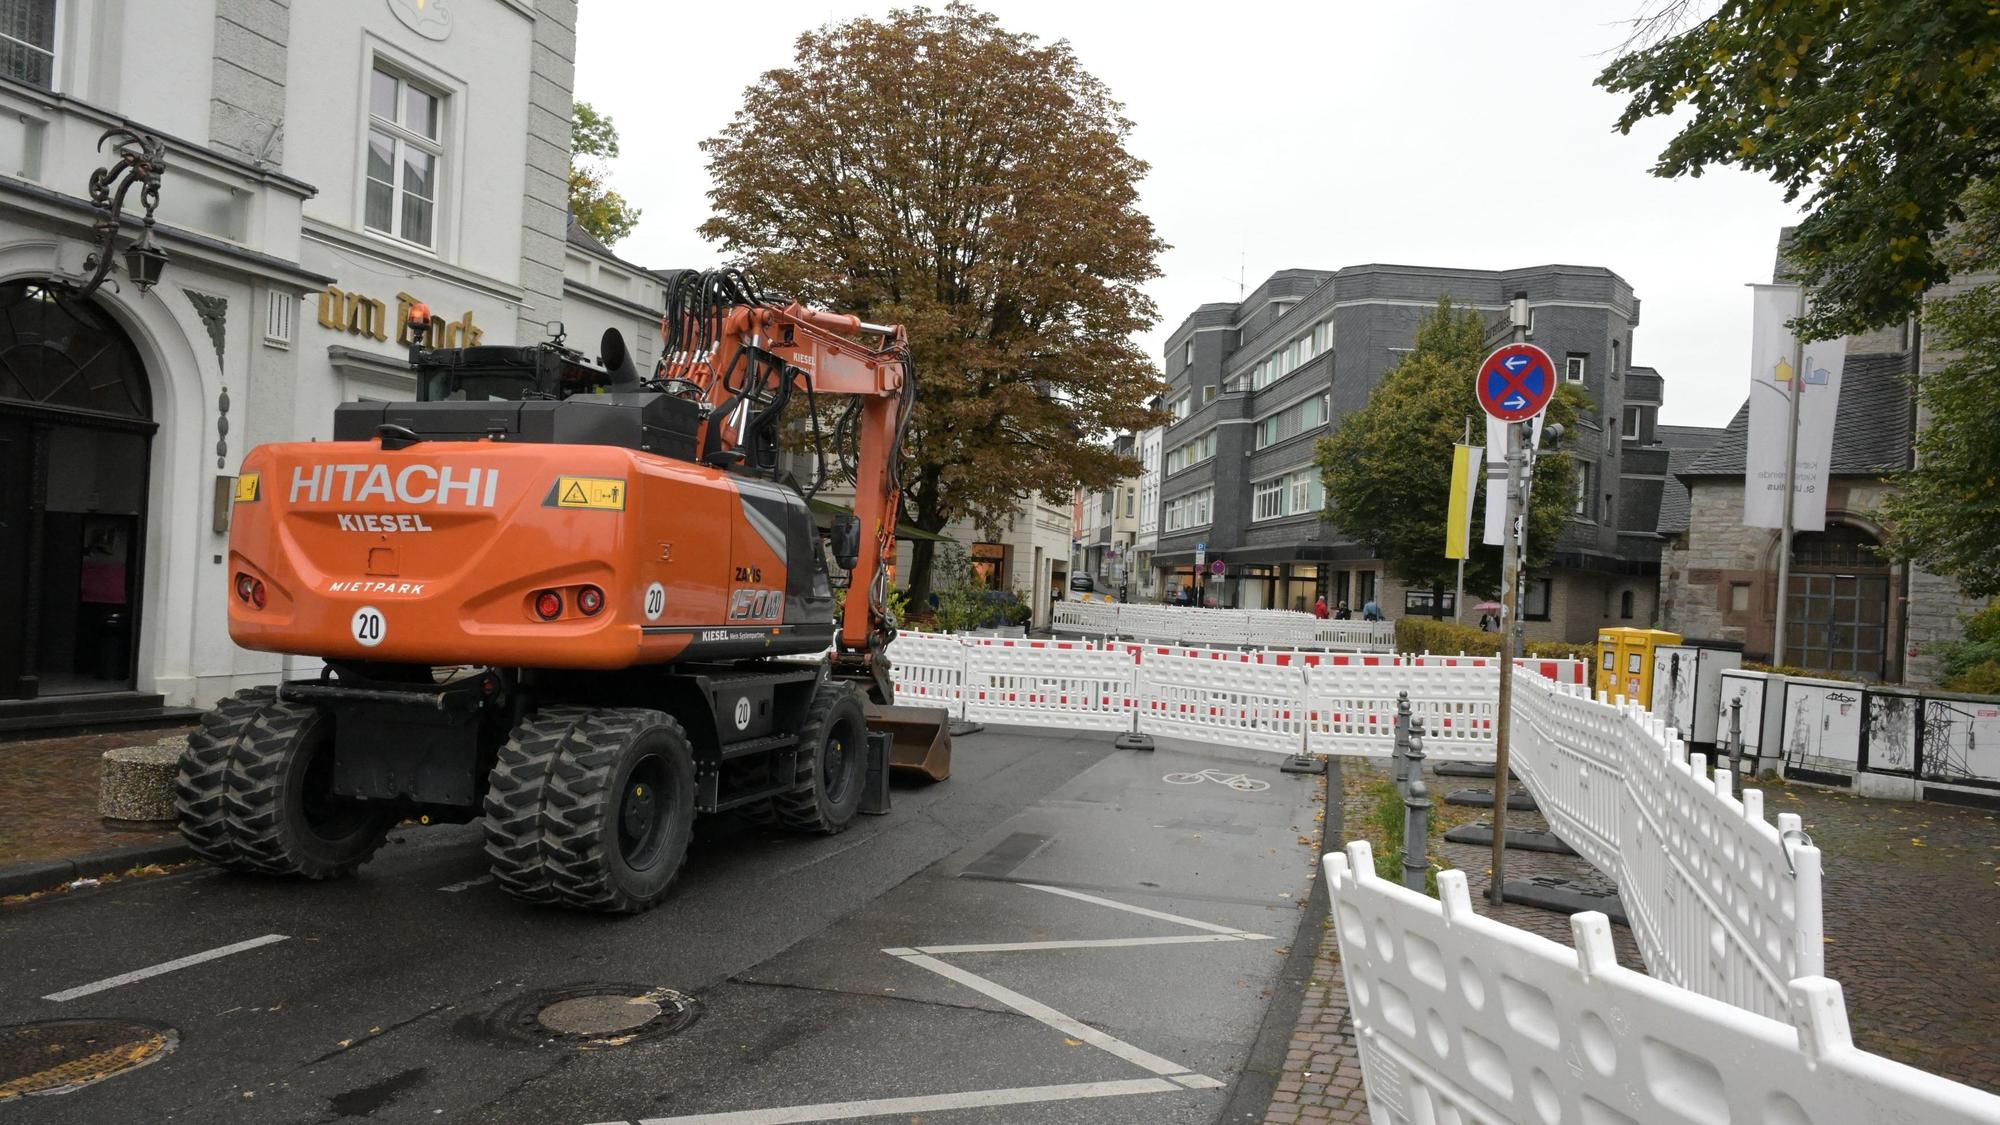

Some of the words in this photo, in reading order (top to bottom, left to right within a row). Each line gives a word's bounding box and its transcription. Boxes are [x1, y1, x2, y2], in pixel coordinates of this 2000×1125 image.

[318, 286, 388, 343] am
[793, 352, 816, 365] KIESEL
[289, 464, 499, 507] HITACHI
[336, 513, 432, 532] KIESEL
[329, 582, 424, 594] MIETPARK
[647, 589, 662, 614] 20
[729, 589, 783, 620] 150W
[358, 613, 380, 640] 20
[702, 630, 729, 642] KIESEL
[738, 703, 748, 724] 20
